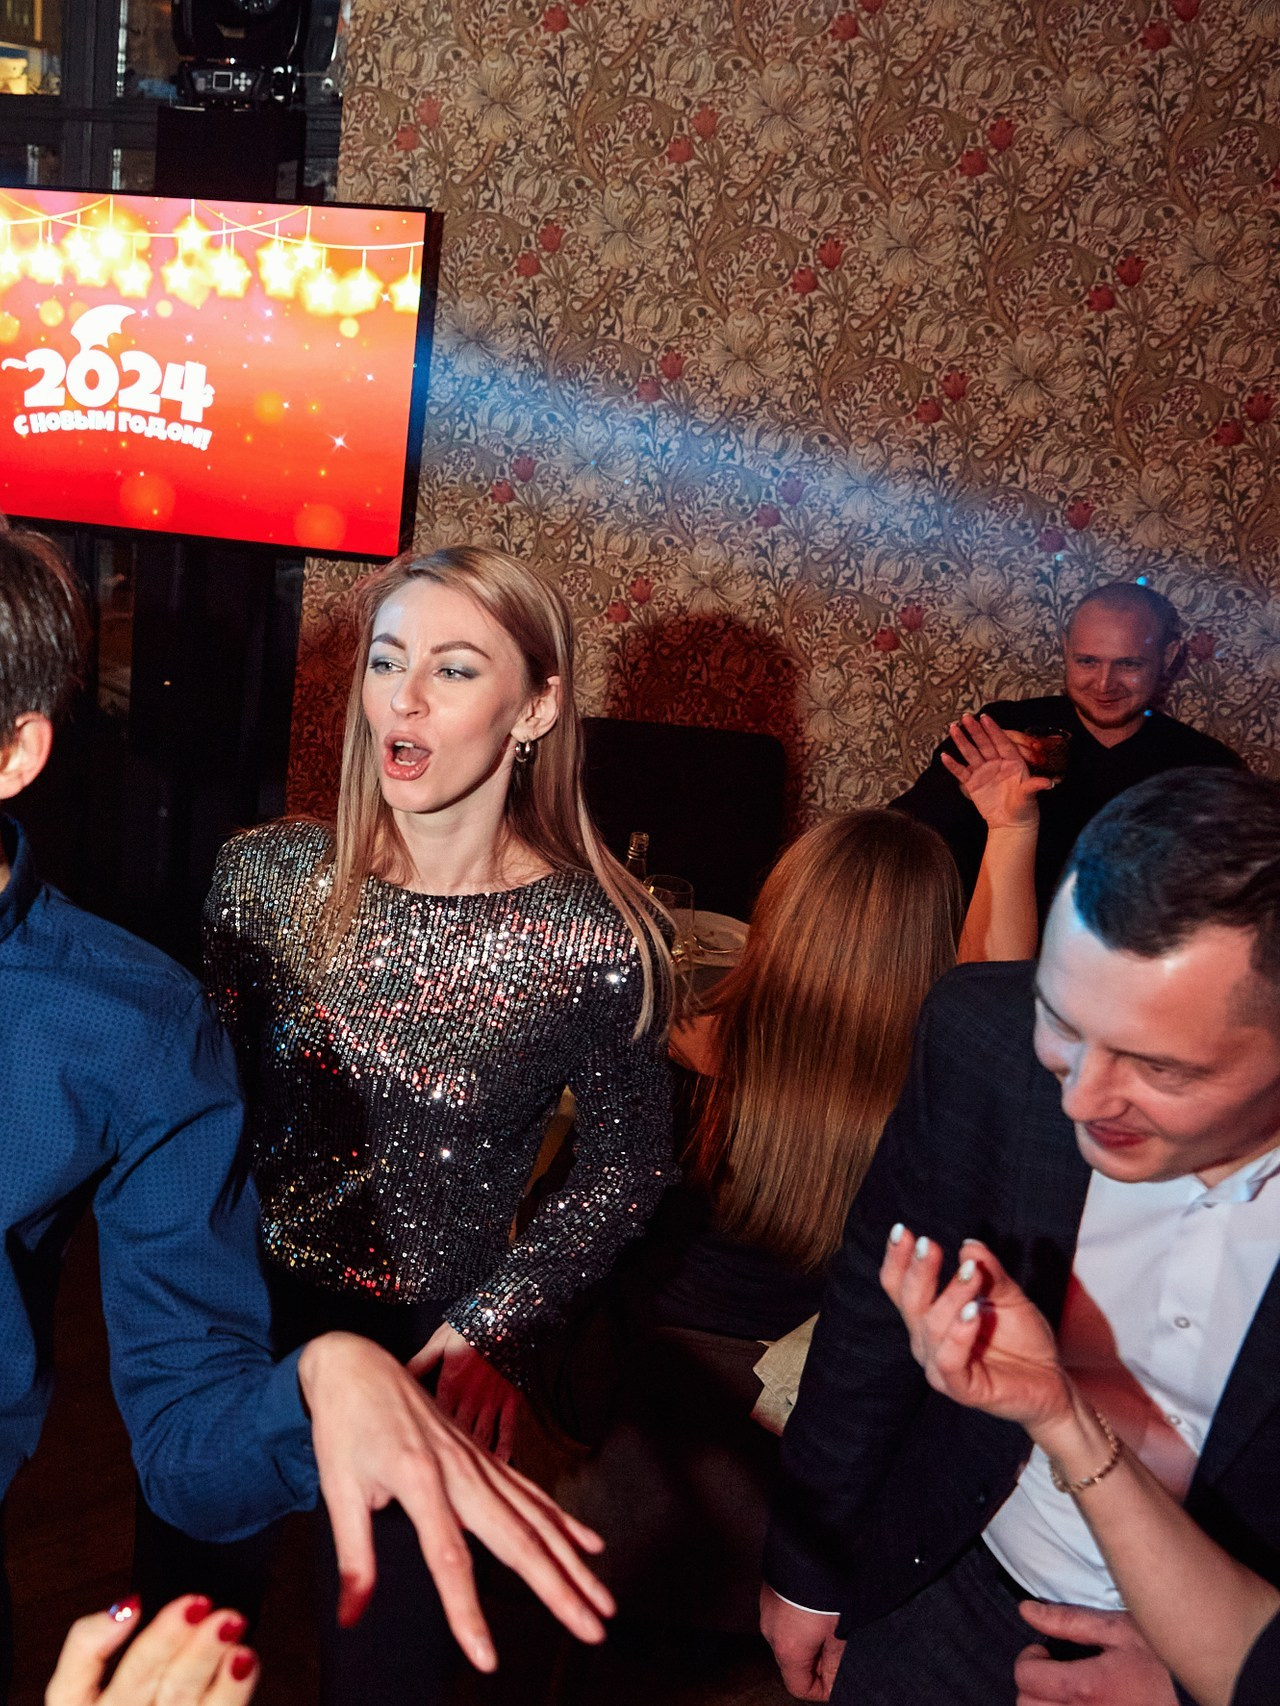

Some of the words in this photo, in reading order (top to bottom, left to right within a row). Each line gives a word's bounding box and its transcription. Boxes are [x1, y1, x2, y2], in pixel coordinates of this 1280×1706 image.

[22, 347, 215, 423] 2024
[13, 414, 29, 435] С
[29, 409, 116, 434] НОВЫМ
[118, 411, 213, 451] ГОДОМ!
